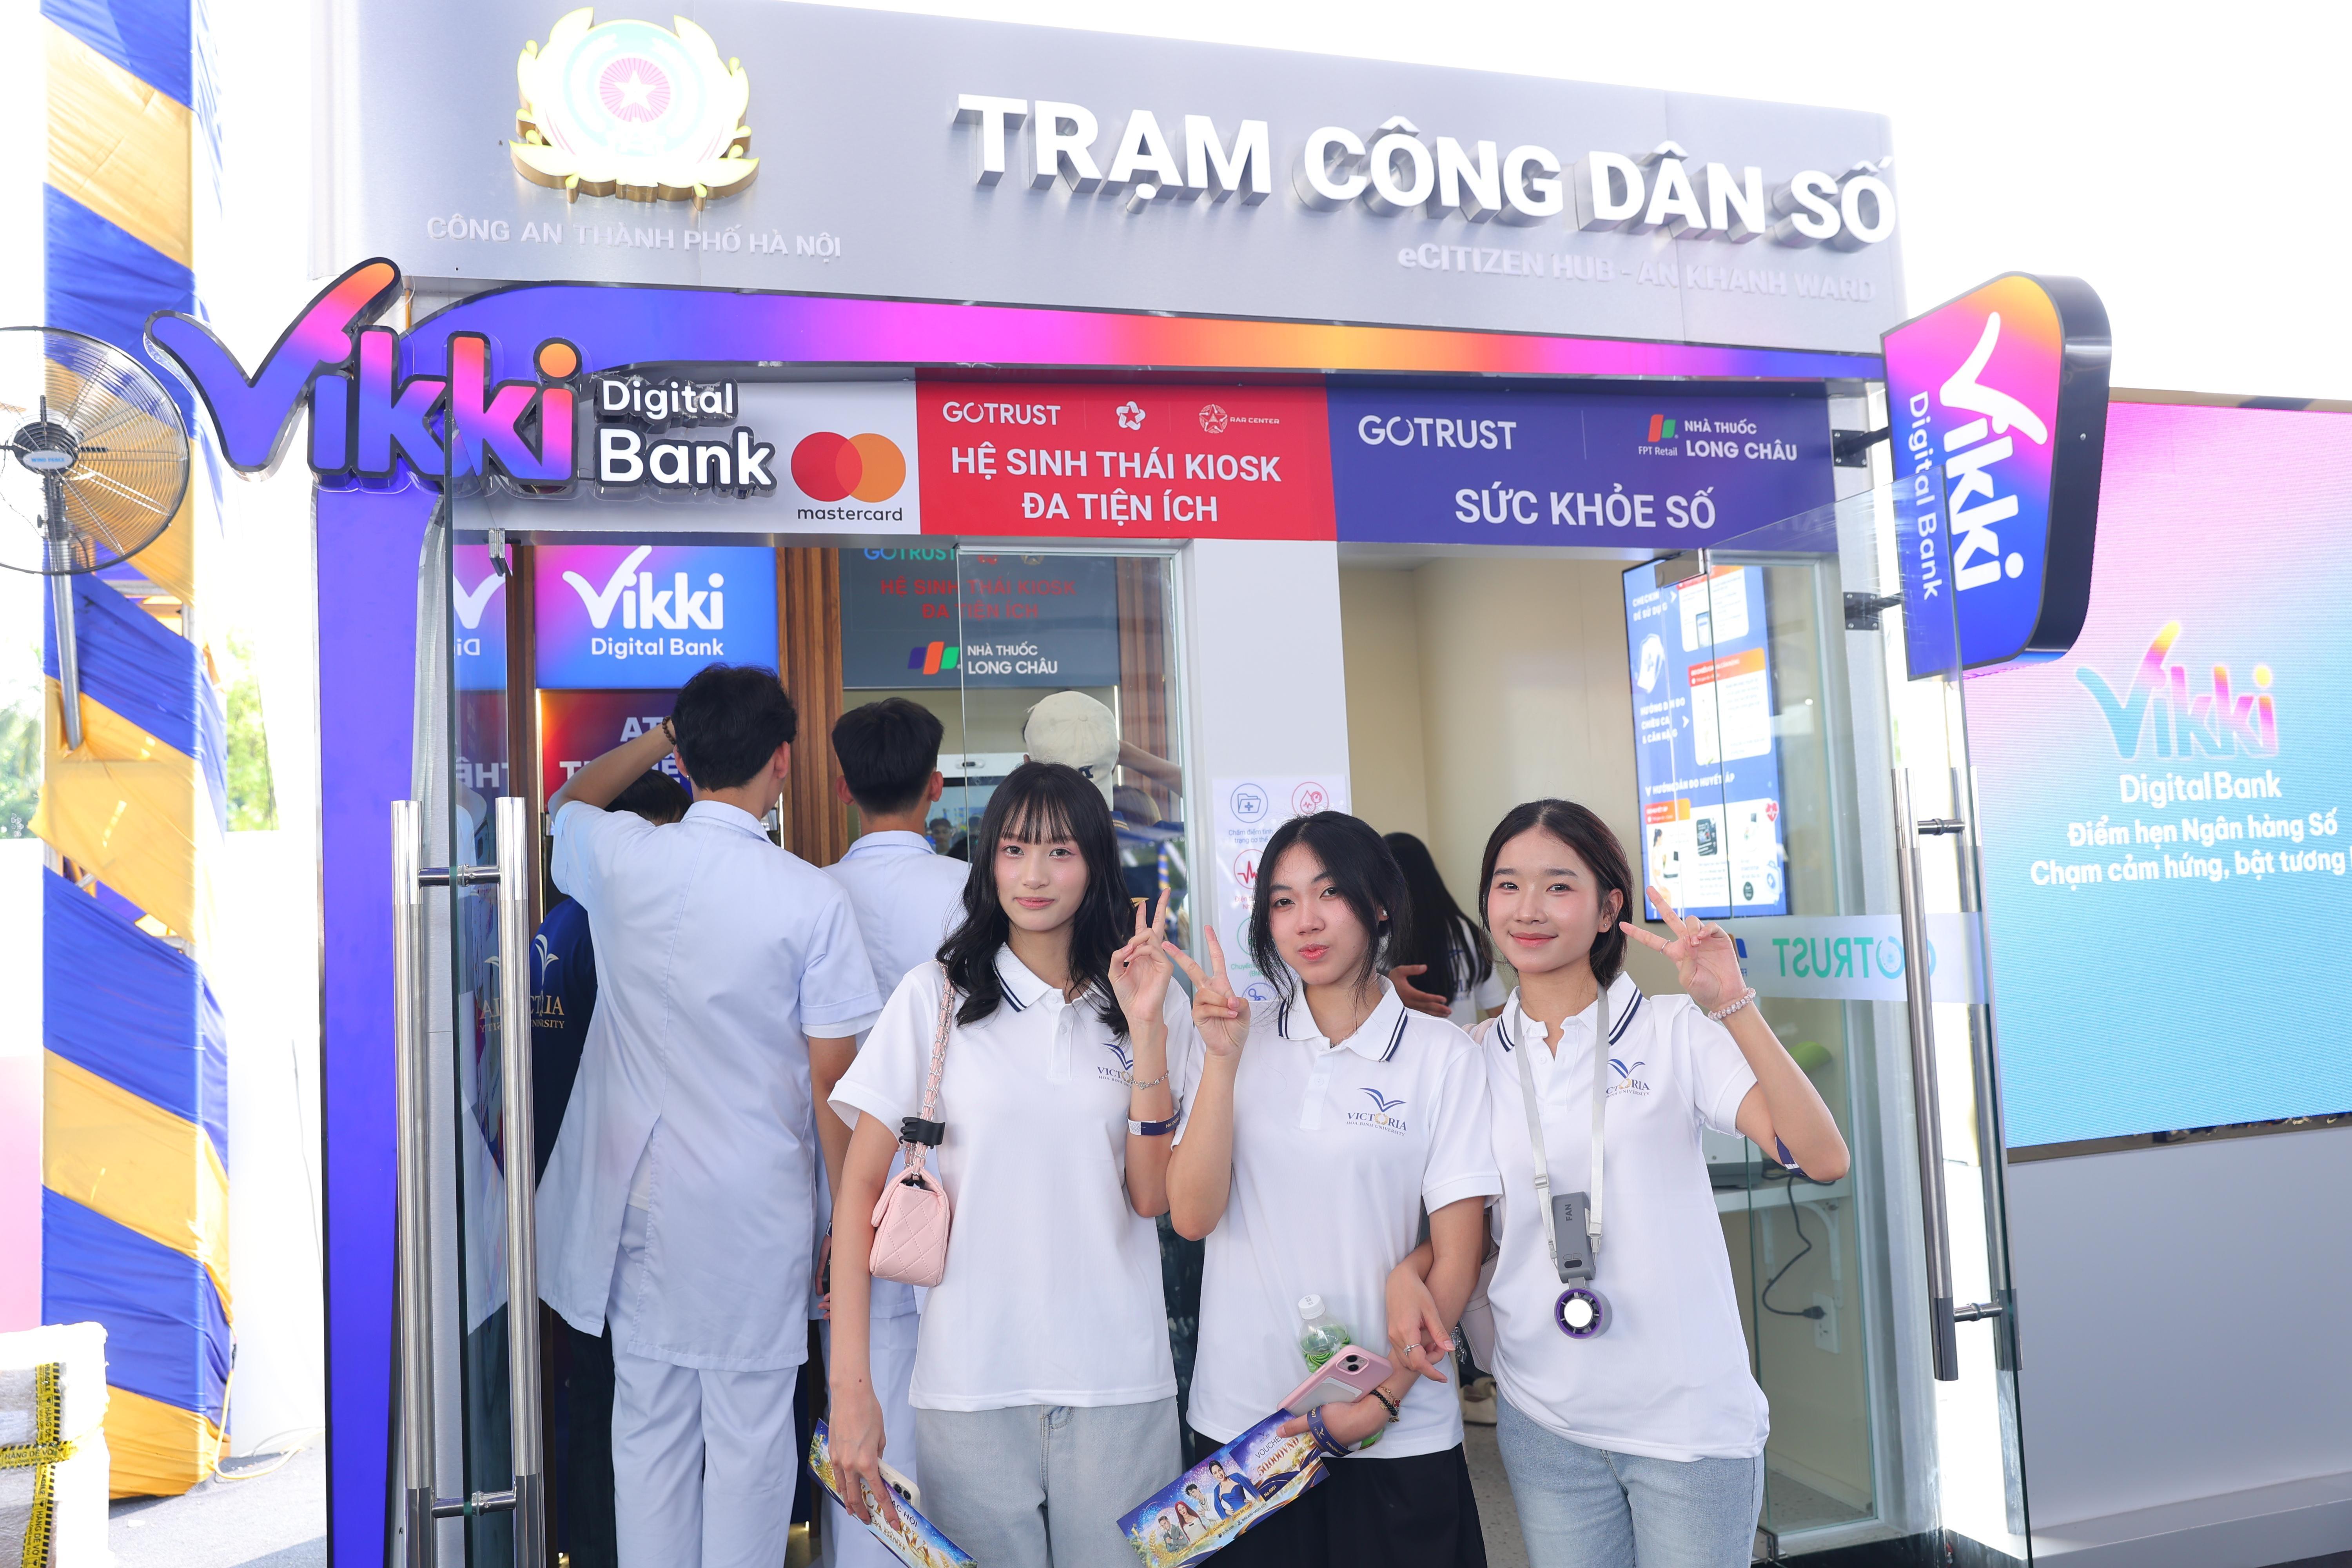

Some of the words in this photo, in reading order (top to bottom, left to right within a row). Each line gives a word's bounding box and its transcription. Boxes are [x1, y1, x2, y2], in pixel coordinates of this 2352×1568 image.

[954, 93, 1272, 206] TRẠM
[1301, 115, 1564, 220] CÔNG
[1586, 140, 1766, 234] DÂN
[1789, 156, 1896, 245] SỐ
[426, 214, 510, 242] CÔNG
[521, 222, 563, 246] AN
[573, 221, 675, 250] THÀNH
[684, 224, 742, 254] PHỐ
[749, 229, 788, 257] HÀ
[796, 230, 841, 263] NỘI
[1397, 242, 1545, 278] eCITIZEN
[1552, 254, 1615, 282] HUB
[1637, 260, 1679, 288] AN
[1687, 265, 1788, 296] KHANH
[1795, 272, 1875, 303] WARD
[145, 258, 581, 487] Vikki
[602, 380, 734, 420] Digital
[942, 401, 1061, 426] GOTRUST
[1358, 414, 1517, 450] GOTRUST
[1684, 417, 1711, 432] NHÀ
[1714, 418, 1757, 435] THUỐC
[600, 428, 772, 486] Bank
[951, 441, 996, 481] HỆ
[1006, 448, 1087, 477] SINH
[1096, 446, 1174, 479] THÁI
[1185, 454, 1281, 482] KIOSK
[1638, 446, 1653, 456] FPT
[1655, 446, 1678, 456] Retail
[1686, 439, 1739, 459] LONG
[1744, 439, 1798, 461] CHÂU
[1908, 390, 1936, 506] Digital
[1939, 311, 2048, 592] Vikki
[797, 507, 903, 522] mastercard
[1022, 492, 1070, 519] ĐA
[1077, 488, 1152, 526] TIỆN
[1163, 489, 1218, 522] ÍCH
[1455, 481, 1539, 525] SỨC
[1550, 483, 1656, 528] KHỎE
[1666, 486, 1716, 530] SỐ
[1917, 512, 1943, 601] Bank
[562, 545, 724, 630] Vikki
[880, 575, 907, 598] HỆ
[913, 579, 959, 595] SINH
[966, 576, 1011, 595] THÁI
[1017, 579, 1077, 595] KIOSK
[922, 603, 950, 619] ĐA
[955, 600, 999, 621] TIỆN
[1005, 599, 1038, 619] ÍCH
[592, 637, 664, 660] Digital
[670, 638, 724, 657] Bank
[967, 642, 991, 657] NHÀ
[995, 641, 1038, 657] THUỐC
[968, 660, 1012, 675] LONG
[1015, 657, 1058, 675] CHÂU
[2075, 620, 2279, 760] Vikki
[620, 717, 663, 742] AT
[2119, 771, 2211, 809] Digital
[2214, 769, 2283, 800] Bank
[2067, 815, 2130, 847] Điểm
[2135, 818, 2178, 850] hẹn
[2182, 816, 2243, 847] Ngân
[2247, 814, 2304, 843] hàng
[2308, 807, 2338, 836] Số
[2031, 860, 2102, 891] Chạm
[2107, 853, 2159, 882] cảm
[2164, 852, 2230, 882] hứng,
[2235, 849, 2275, 880] bật
[2279, 849, 2346, 875] tương
[1096, 1066, 1132, 1083] VICTO
[1606, 1078, 1651, 1094] CTORIA
[1347, 1112, 1407, 1131] VICTORIA
[1375, 1124, 1405, 1137] UNIVERSITY
[1564, 1204, 1573, 1221] FAN
[1255, 1435, 1283, 1458] VOUCHE
[1257, 1436, 1299, 1476] 50.000VNĐ
[1263, 1485, 1277, 1497] No.0001
[903, 1511, 918, 1528] HỘI
